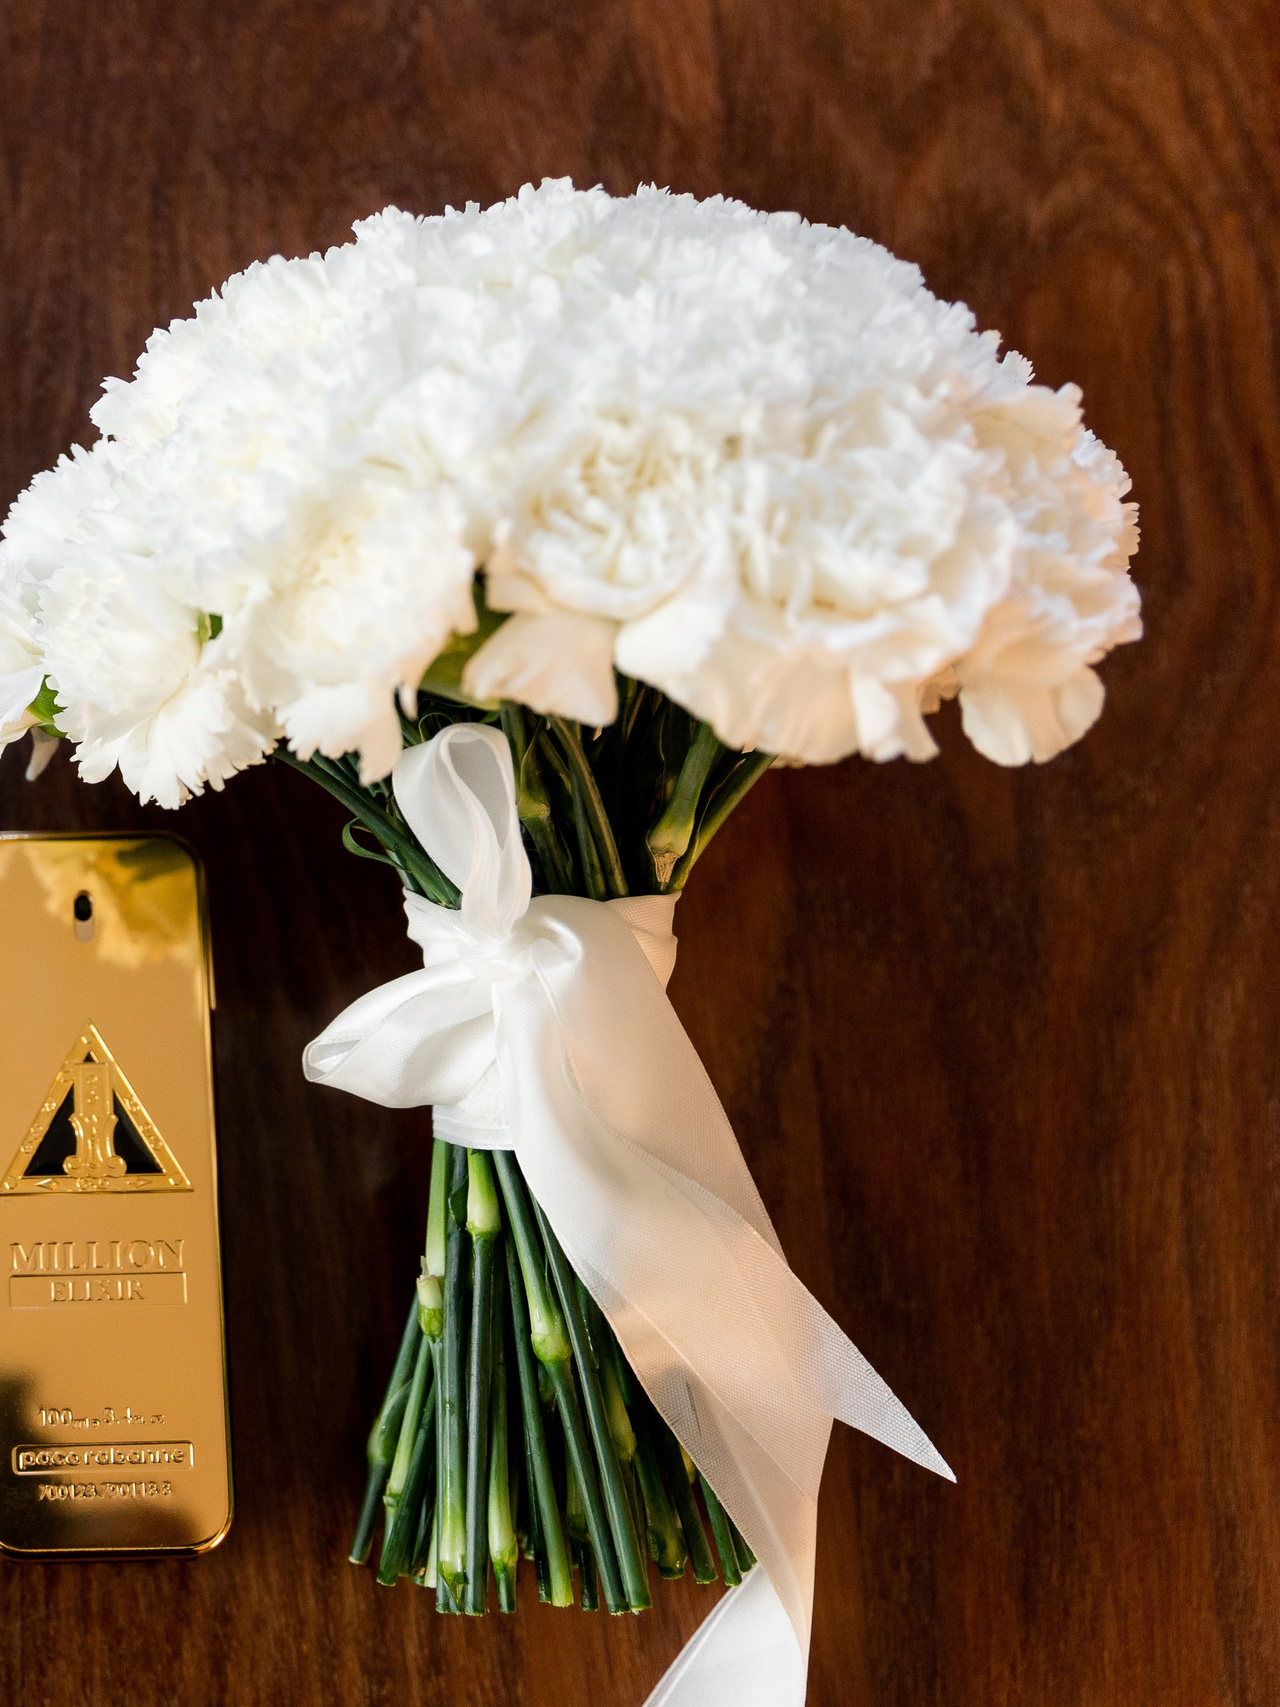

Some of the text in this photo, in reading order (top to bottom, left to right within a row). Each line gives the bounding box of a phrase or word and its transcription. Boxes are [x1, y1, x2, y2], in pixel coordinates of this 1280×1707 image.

[9, 1239, 185, 1272] MILLION
[49, 1279, 145, 1303] ELIXIR
[19, 1447, 187, 1471] paco rabanne
